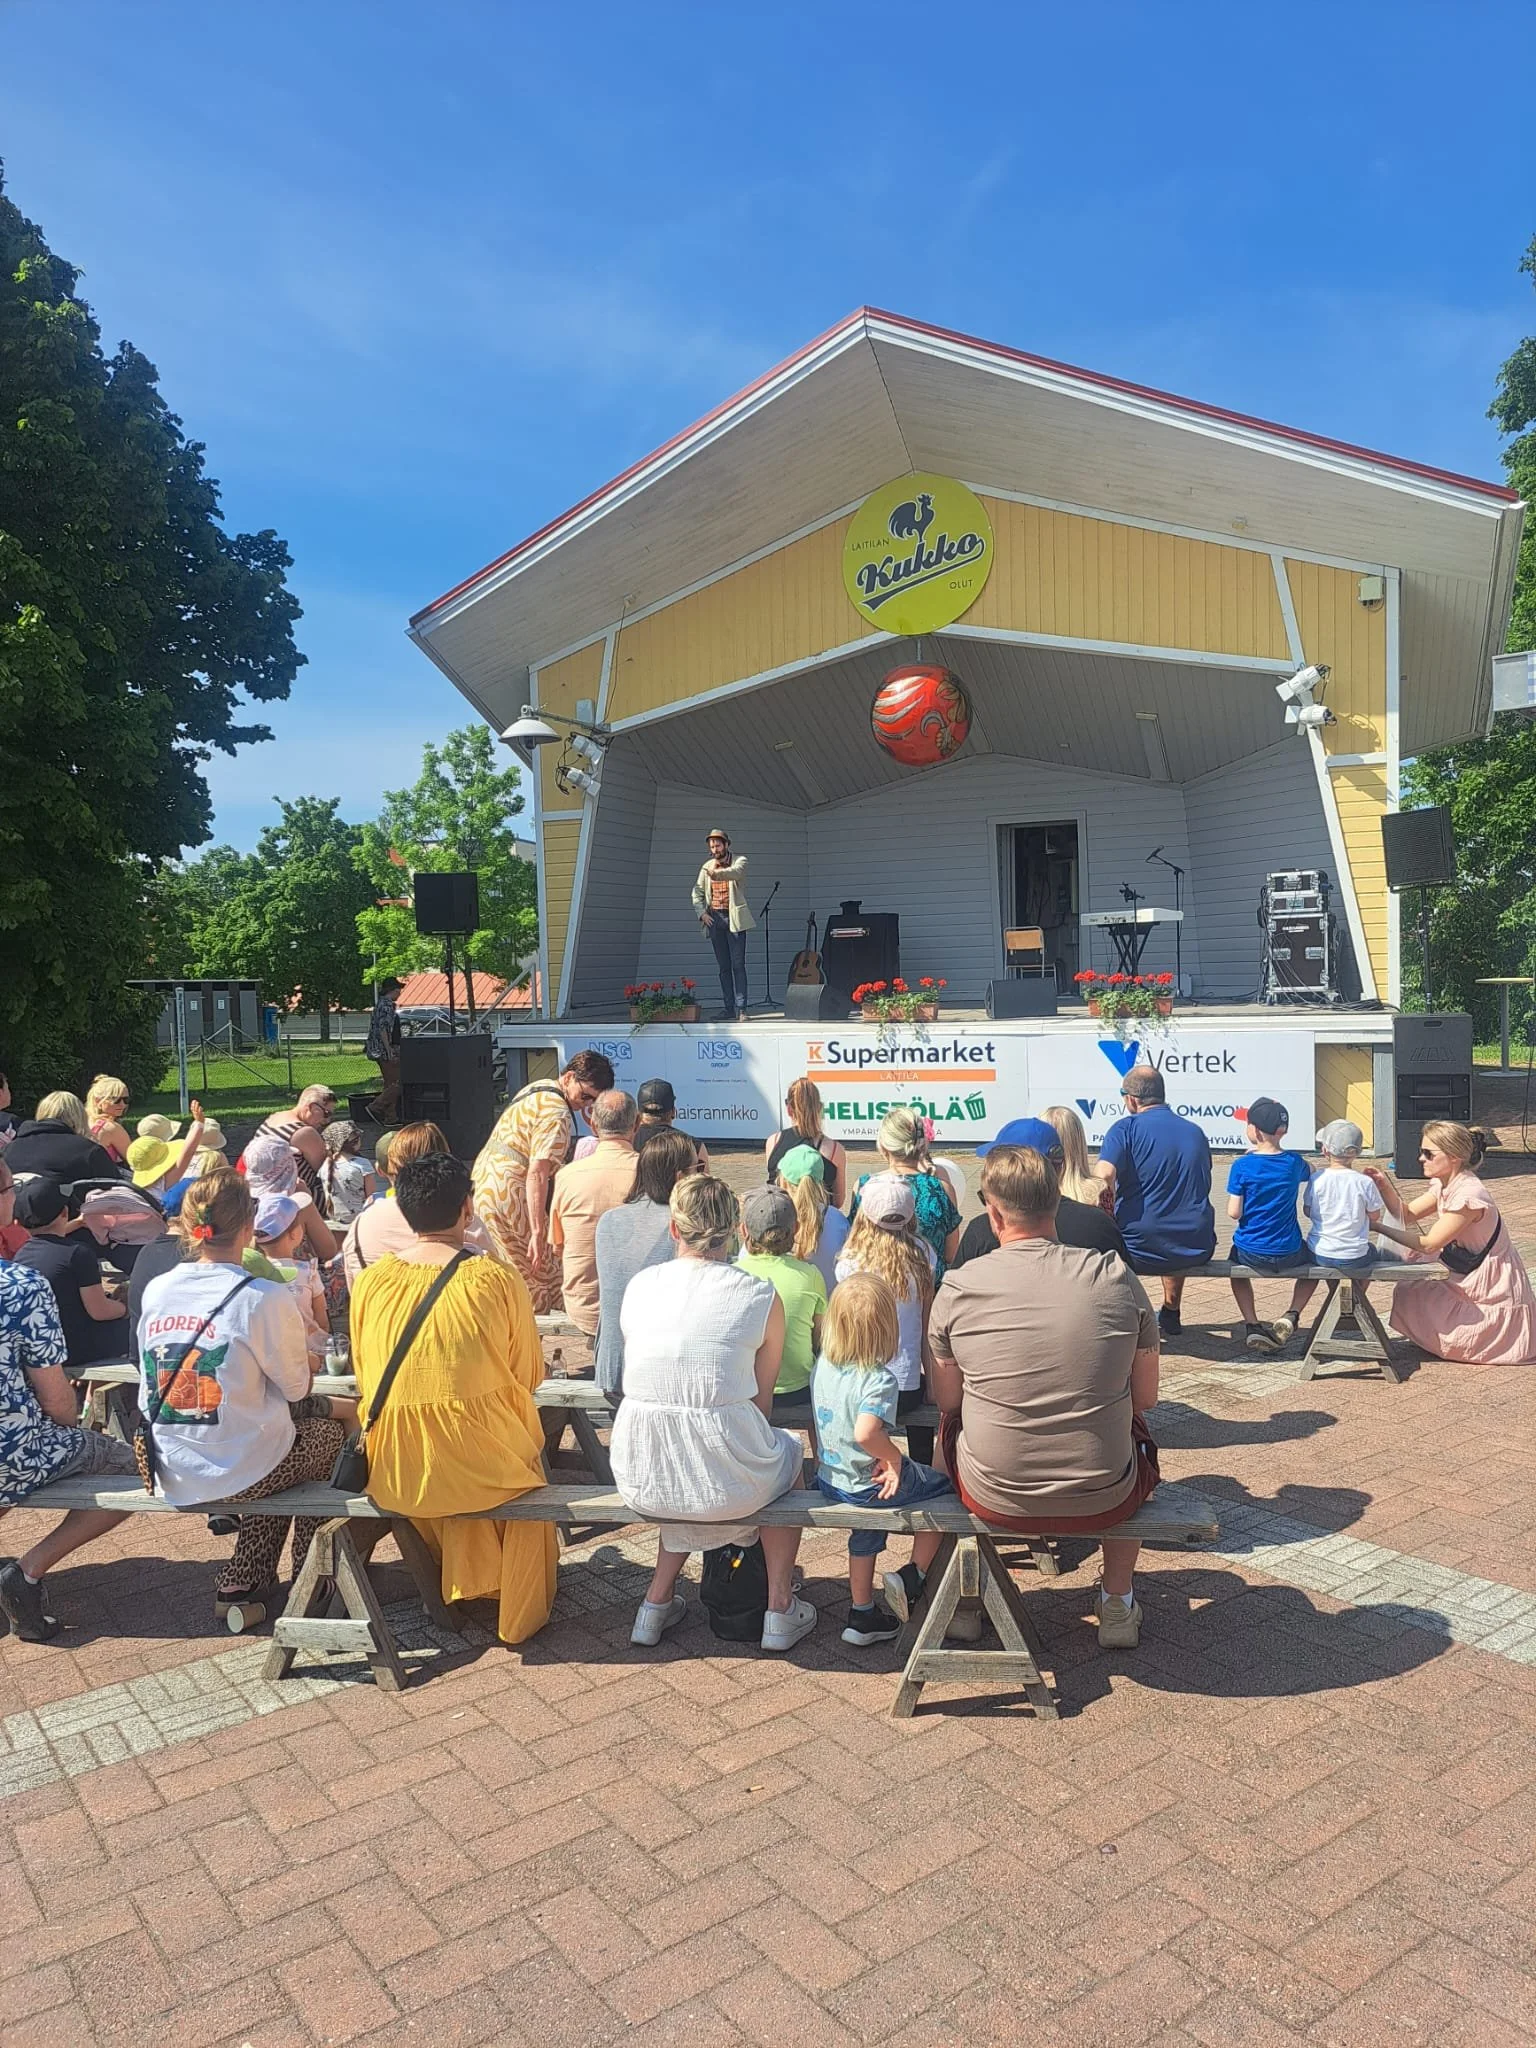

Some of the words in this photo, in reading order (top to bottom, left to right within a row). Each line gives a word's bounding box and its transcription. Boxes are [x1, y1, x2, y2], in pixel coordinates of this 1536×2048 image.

[851, 538, 890, 551] LAITILAN
[857, 533, 984, 596] Kukko
[949, 580, 973, 590] OLUT
[697, 1041, 742, 1060] NSG
[827, 1040, 996, 1069] Supermarket
[1147, 1049, 1236, 1073] Vertek
